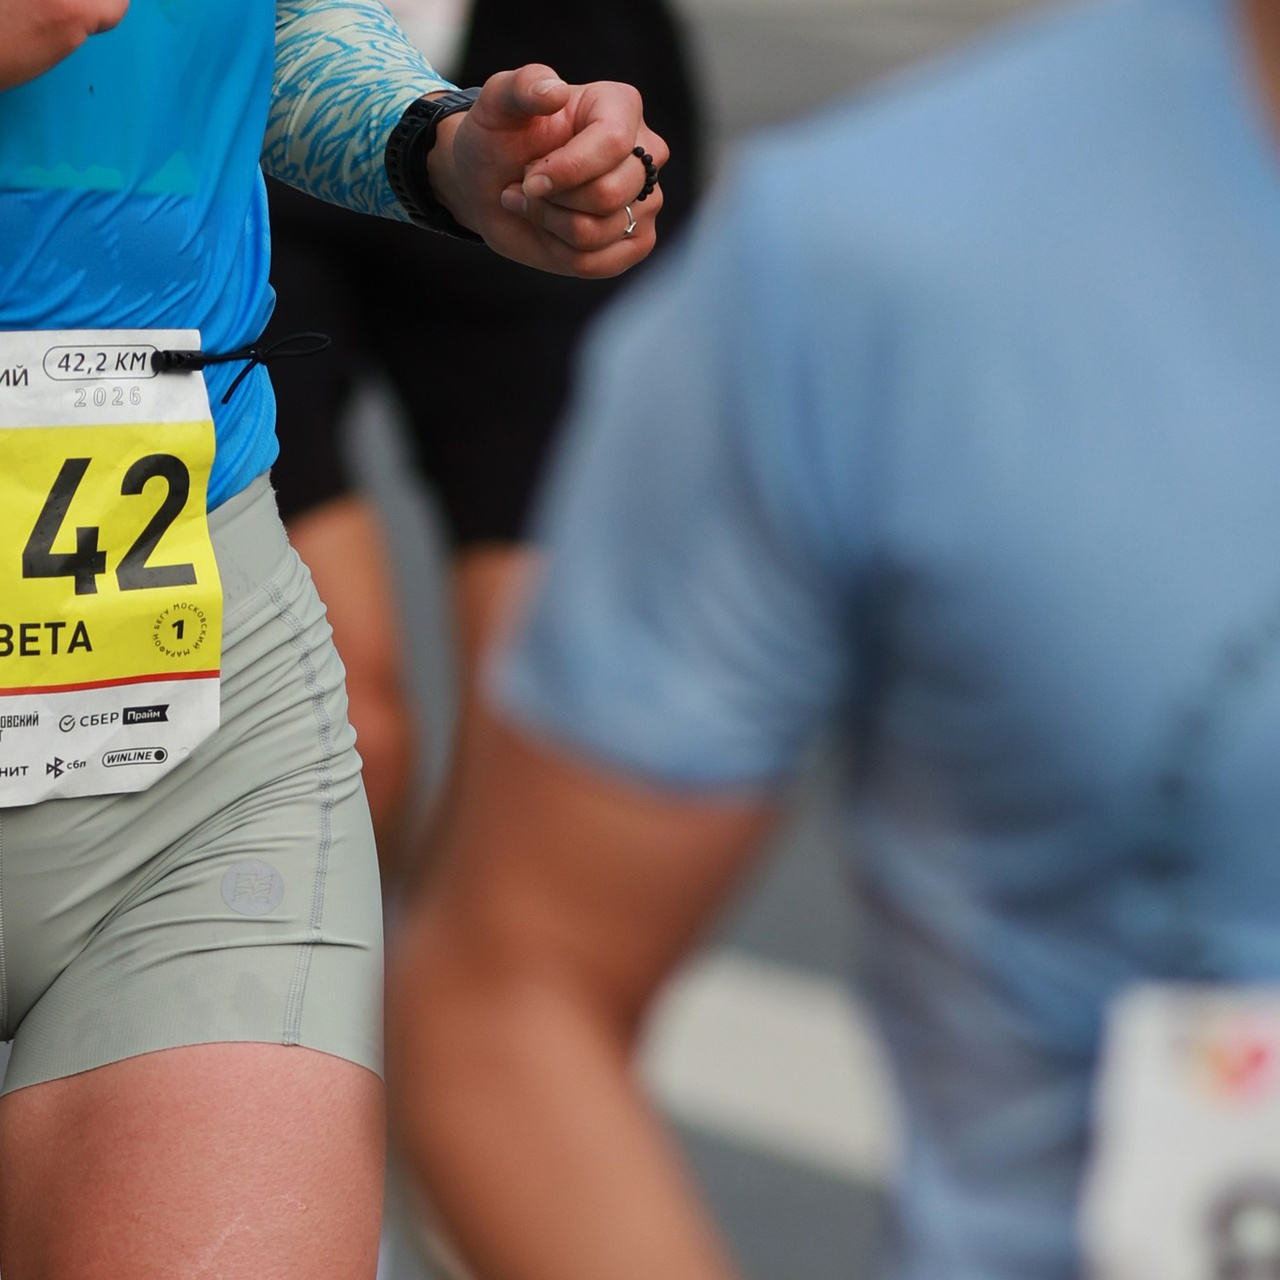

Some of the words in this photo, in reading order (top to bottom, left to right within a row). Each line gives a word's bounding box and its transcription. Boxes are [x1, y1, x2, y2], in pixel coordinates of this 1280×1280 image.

[58, 352, 108, 375] 42,2
[74, 387, 142, 408] 2026
[171, 619, 184, 640] 1
[80, 712, 119, 727] СБЕР
[127, 710, 161, 722] Прайм
[66, 759, 87, 770] сбп
[106, 751, 152, 764] WINLINE
